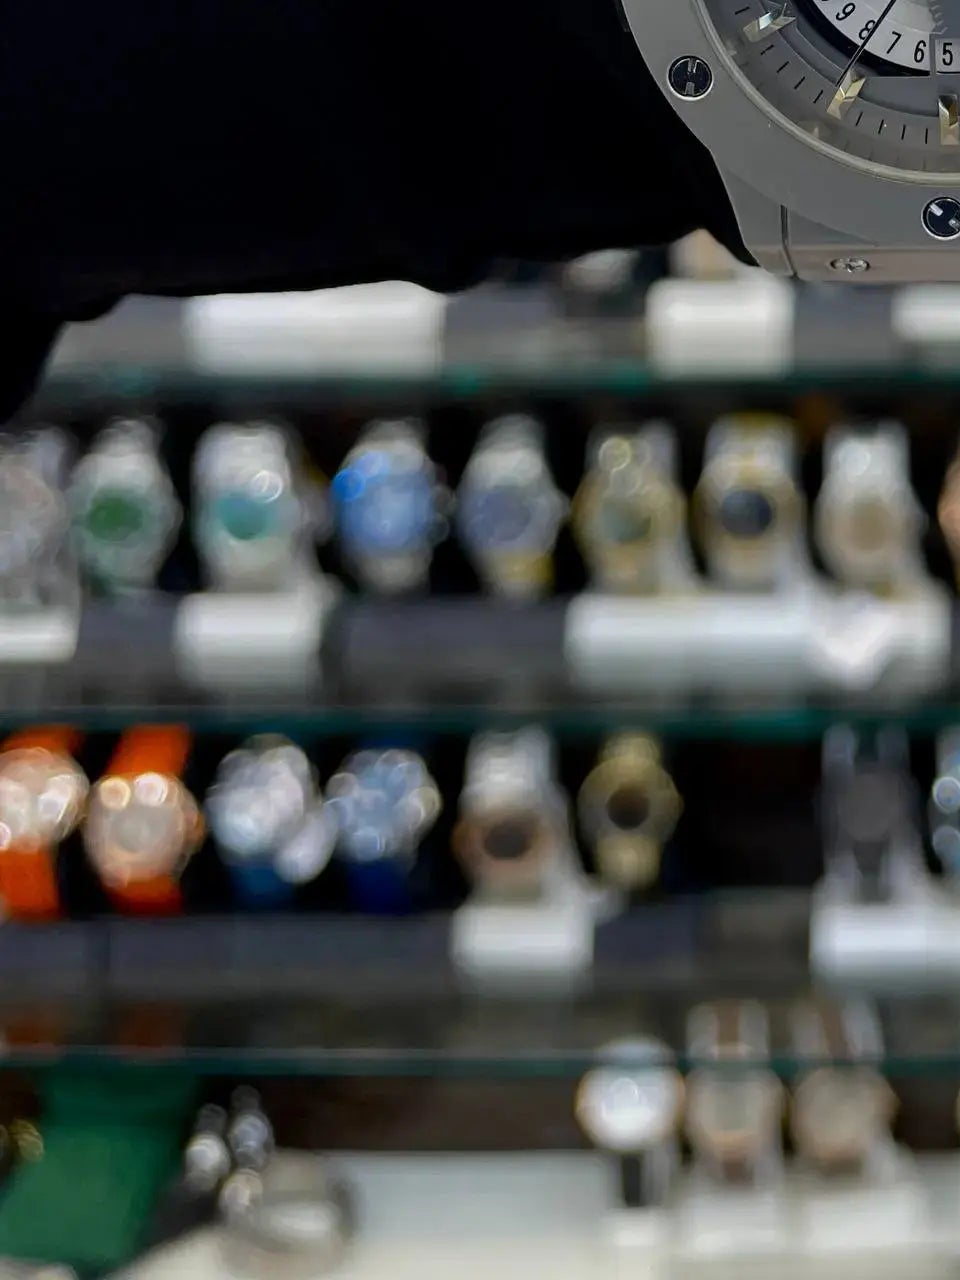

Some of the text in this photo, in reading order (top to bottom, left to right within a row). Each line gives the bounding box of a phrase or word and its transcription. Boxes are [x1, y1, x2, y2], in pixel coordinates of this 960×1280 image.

[835, 2, 954, 66] 9 8 7 6 5
